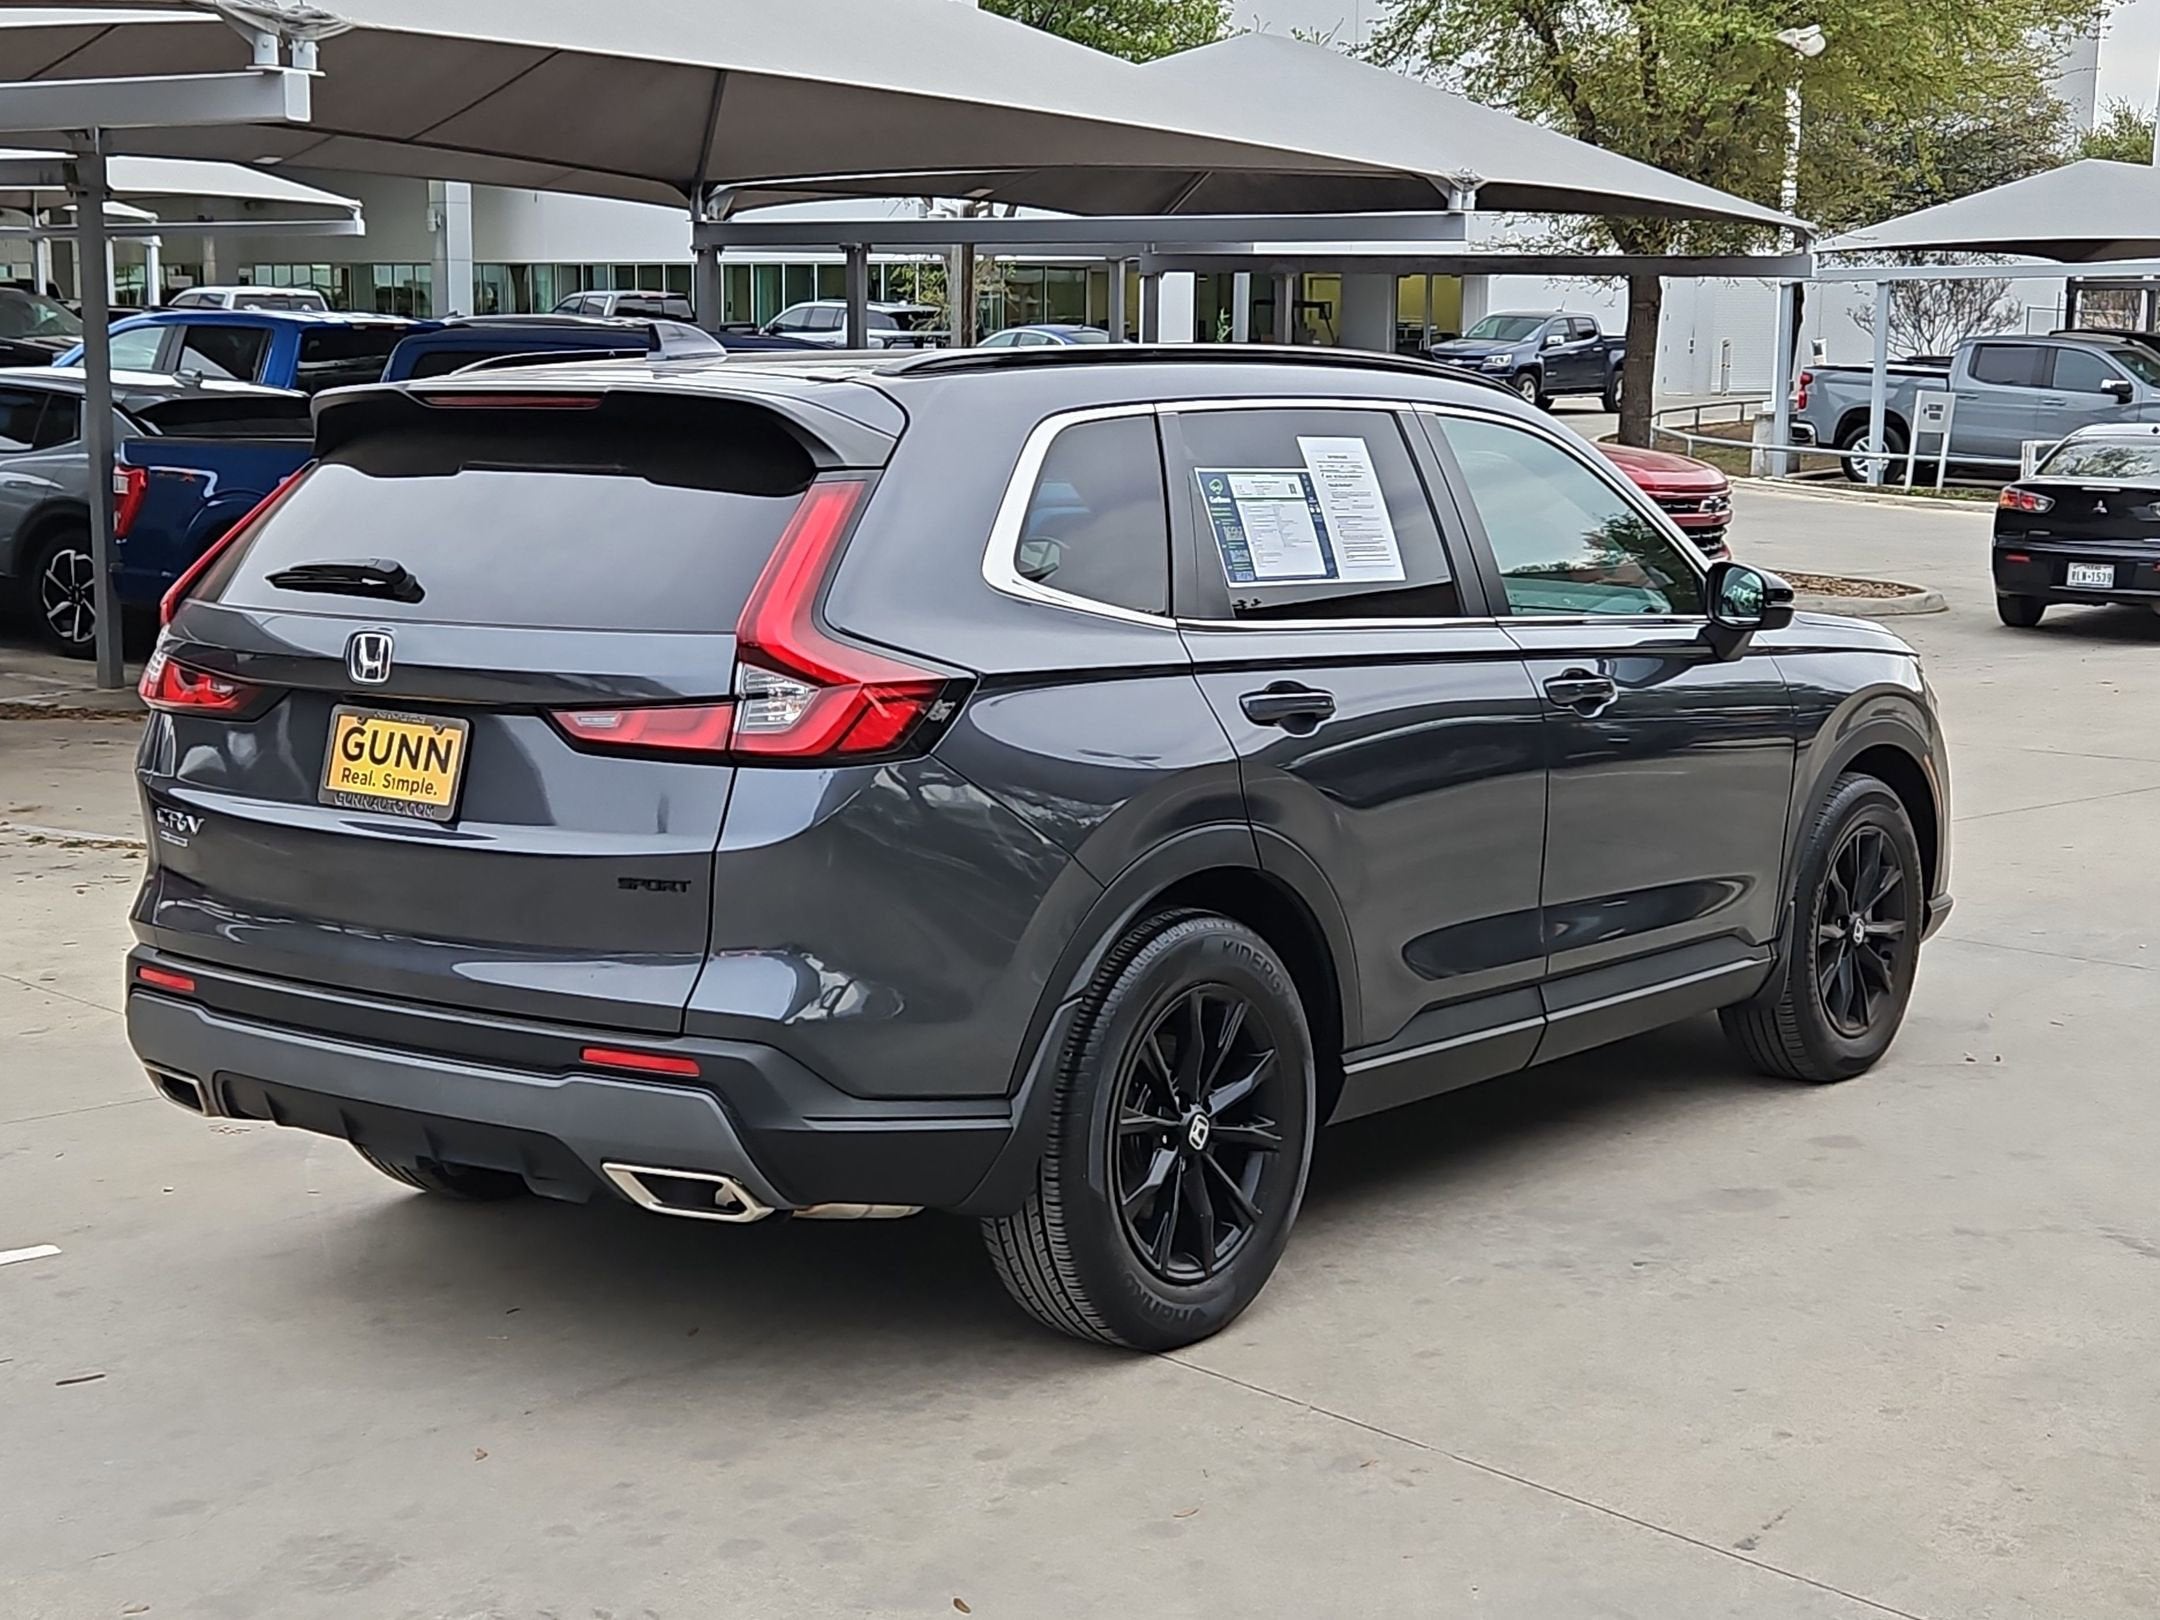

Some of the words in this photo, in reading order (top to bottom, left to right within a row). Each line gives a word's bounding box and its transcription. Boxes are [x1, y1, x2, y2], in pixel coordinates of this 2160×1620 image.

[341, 726, 453, 774] GUNN
[341, 767, 376, 787] Real.
[382, 773, 438, 796] Simple.
